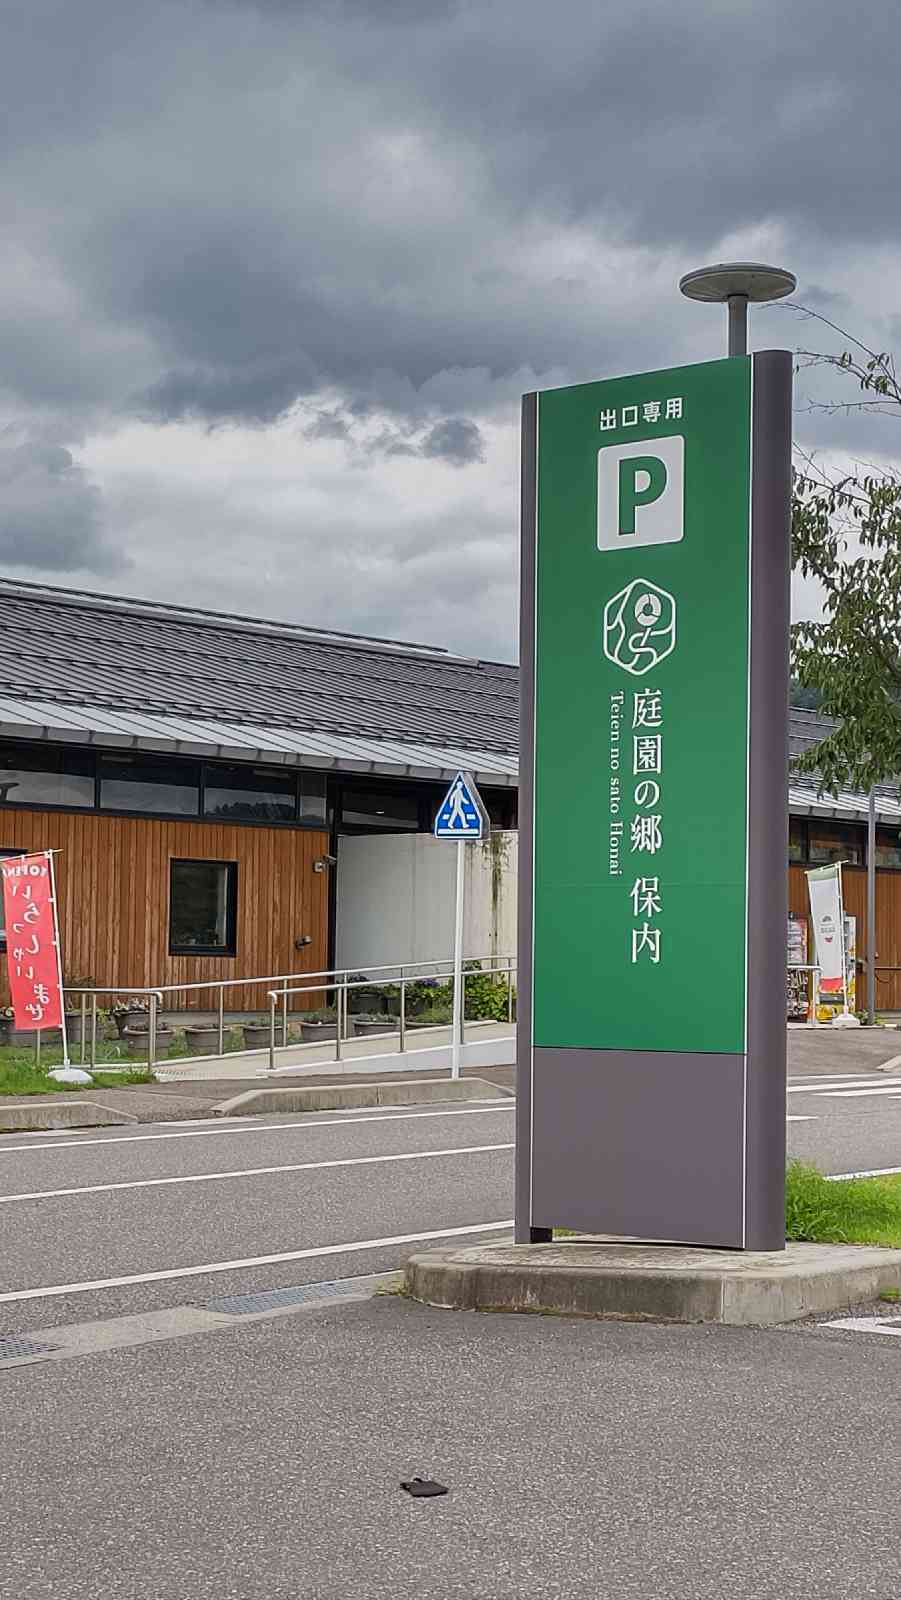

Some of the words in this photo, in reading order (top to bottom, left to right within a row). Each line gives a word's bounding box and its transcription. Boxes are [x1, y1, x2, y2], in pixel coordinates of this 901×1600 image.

[600, 397, 683, 431] 出口専用
[618, 455, 668, 536] P
[609, 690, 624, 742] Teien
[609, 748, 623, 770] no
[629, 688, 664, 855] 庭園の郷
[609, 777, 624, 814] sato
[609, 821, 624, 876] Honai
[629, 876, 664, 963] 保内
